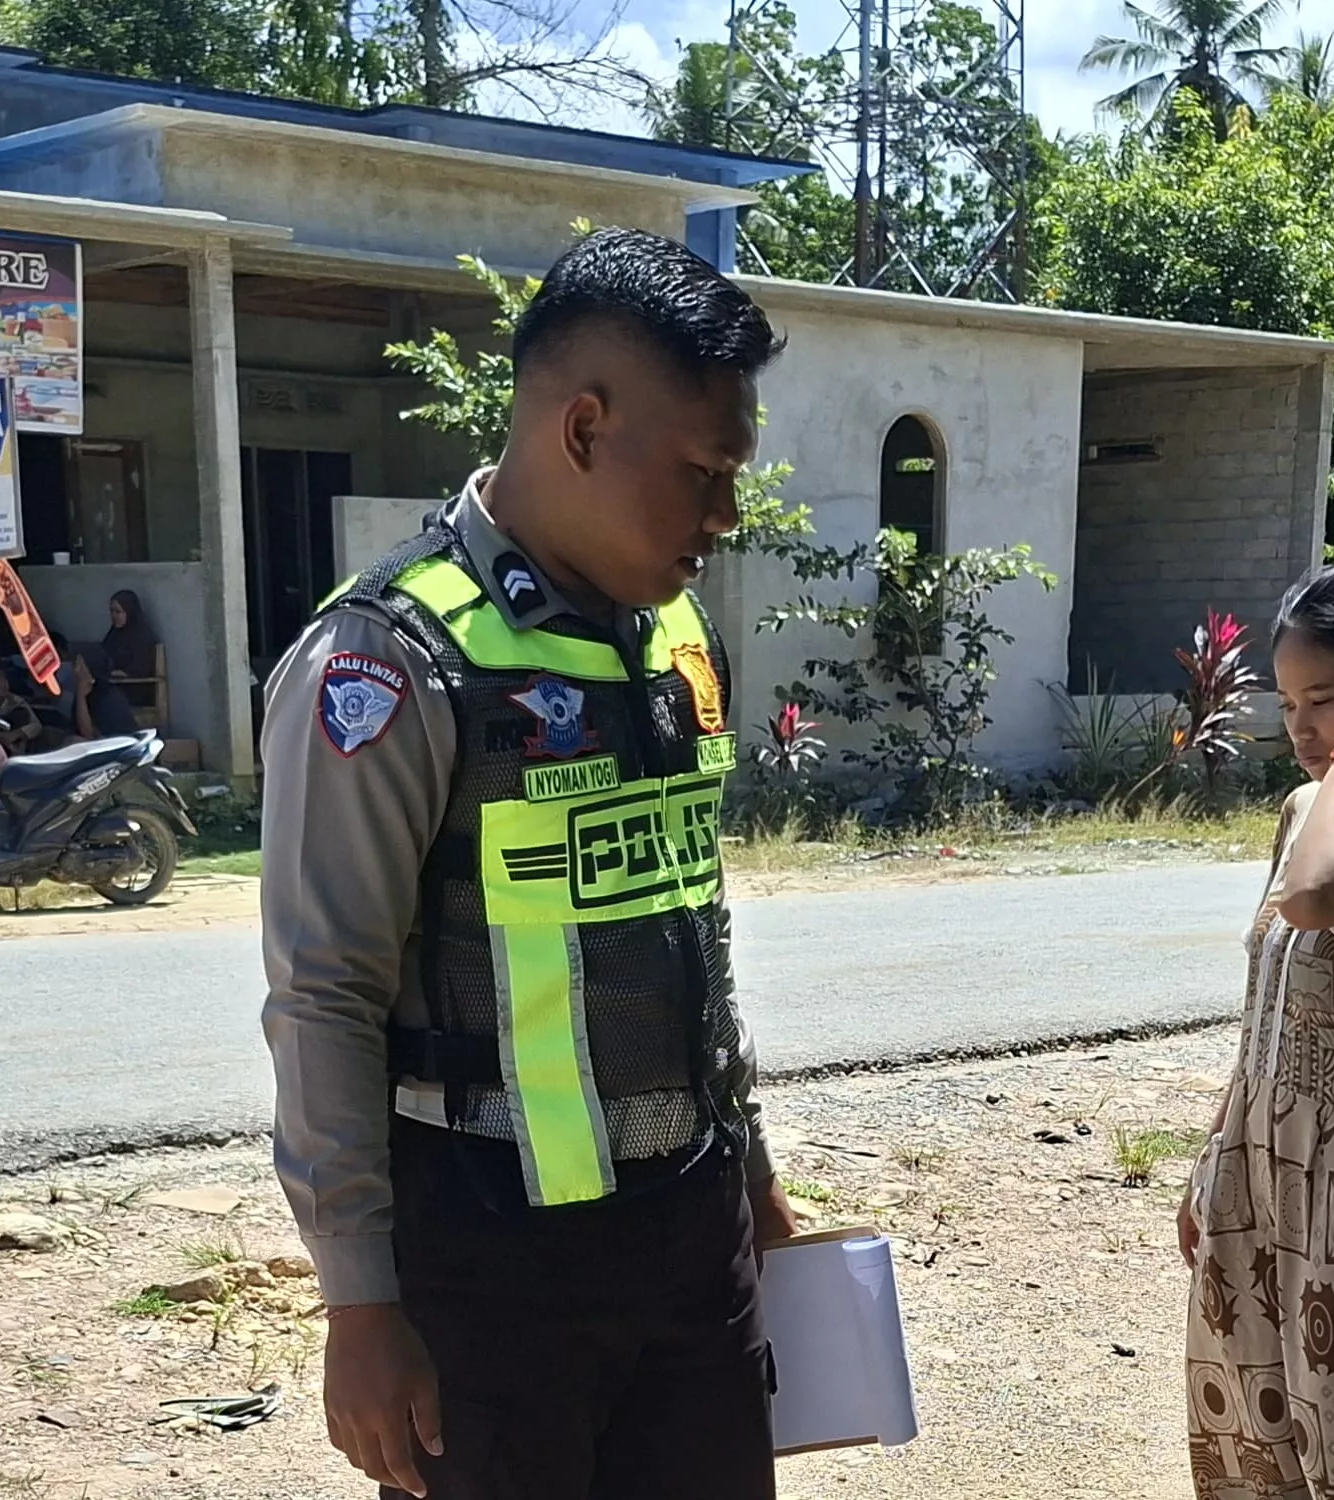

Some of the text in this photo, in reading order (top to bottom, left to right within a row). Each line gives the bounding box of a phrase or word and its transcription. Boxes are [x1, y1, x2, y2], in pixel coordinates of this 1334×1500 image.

[331, 657, 404, 689] LALU LINTAS
[527, 759, 616, 797] I NYOMAN YOGI
